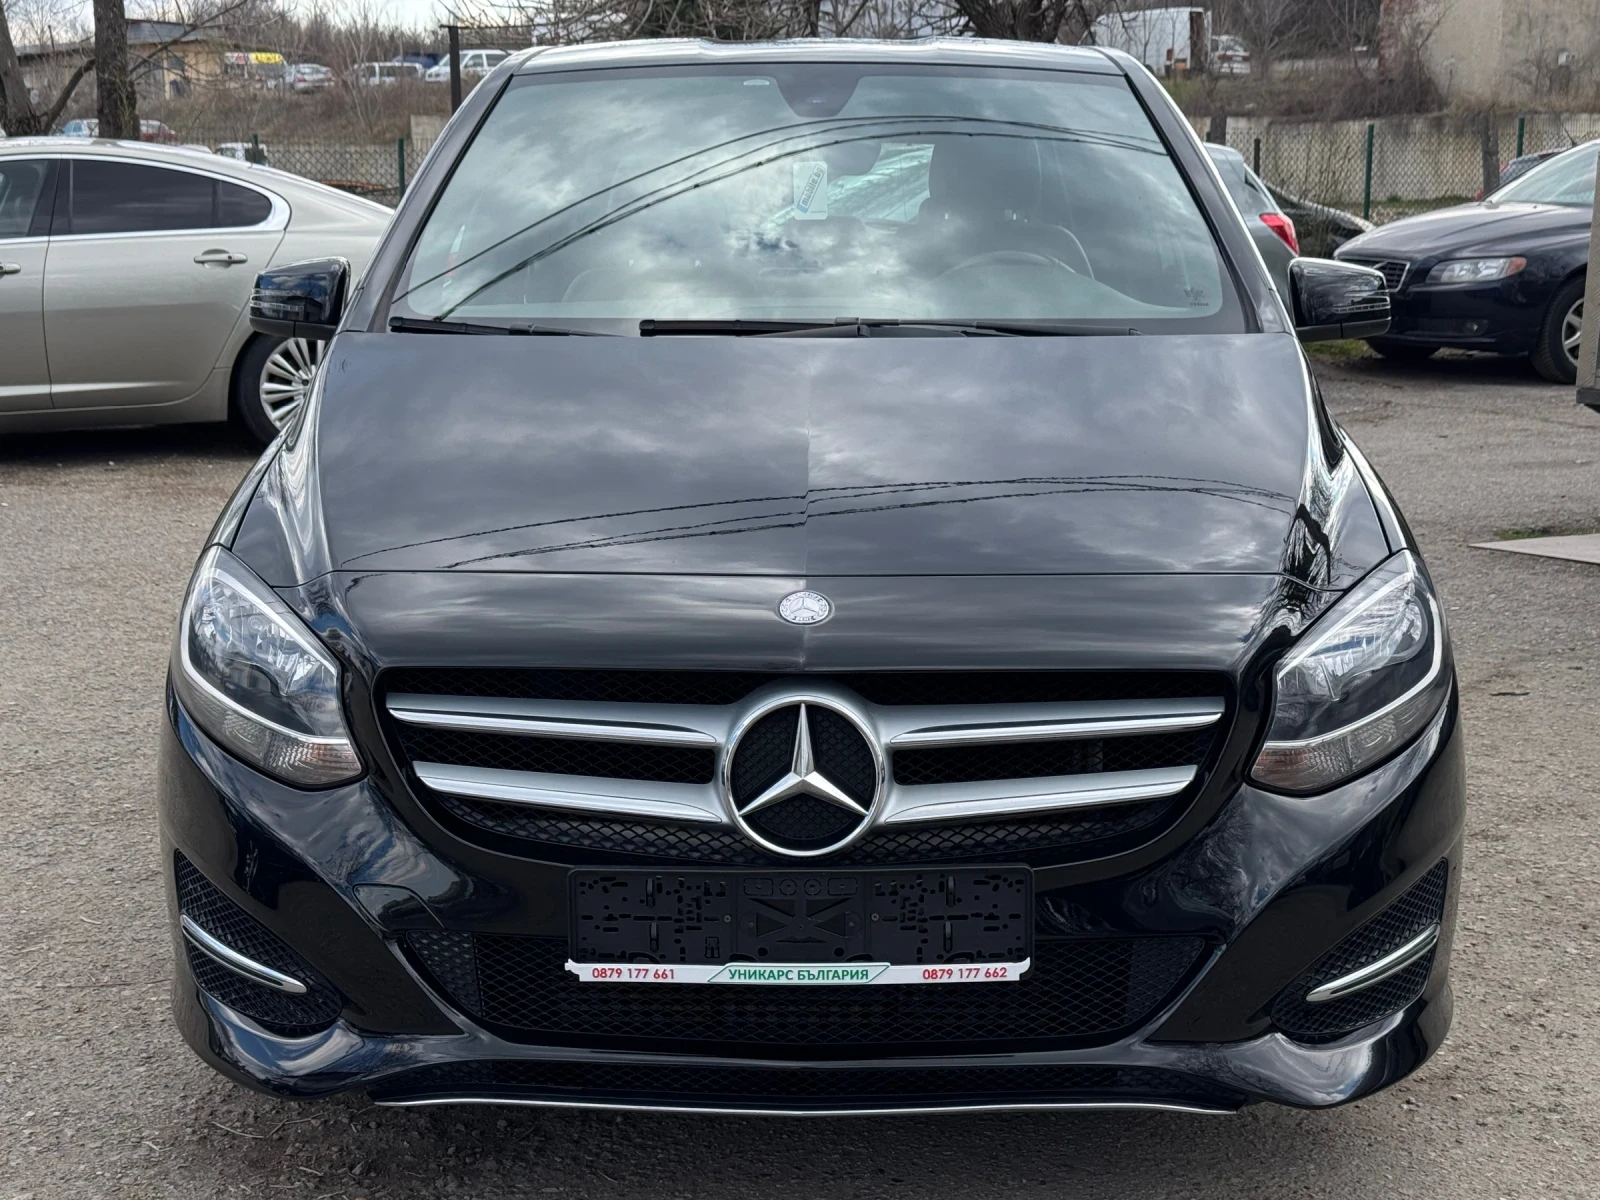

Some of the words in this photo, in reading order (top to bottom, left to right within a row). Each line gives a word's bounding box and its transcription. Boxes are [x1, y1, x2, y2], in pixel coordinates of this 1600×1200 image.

[801, 165, 825, 207] mobile.bg
[592, 967, 623, 979] 0879
[627, 968, 649, 979] 177
[653, 968, 675, 980] 661
[728, 968, 794, 980] УНИКАРС
[797, 969, 869, 981] БЪЛГАРИЯ
[922, 968, 954, 980] 0879
[958, 967, 981, 979] 177
[984, 966, 1007, 979] 662
